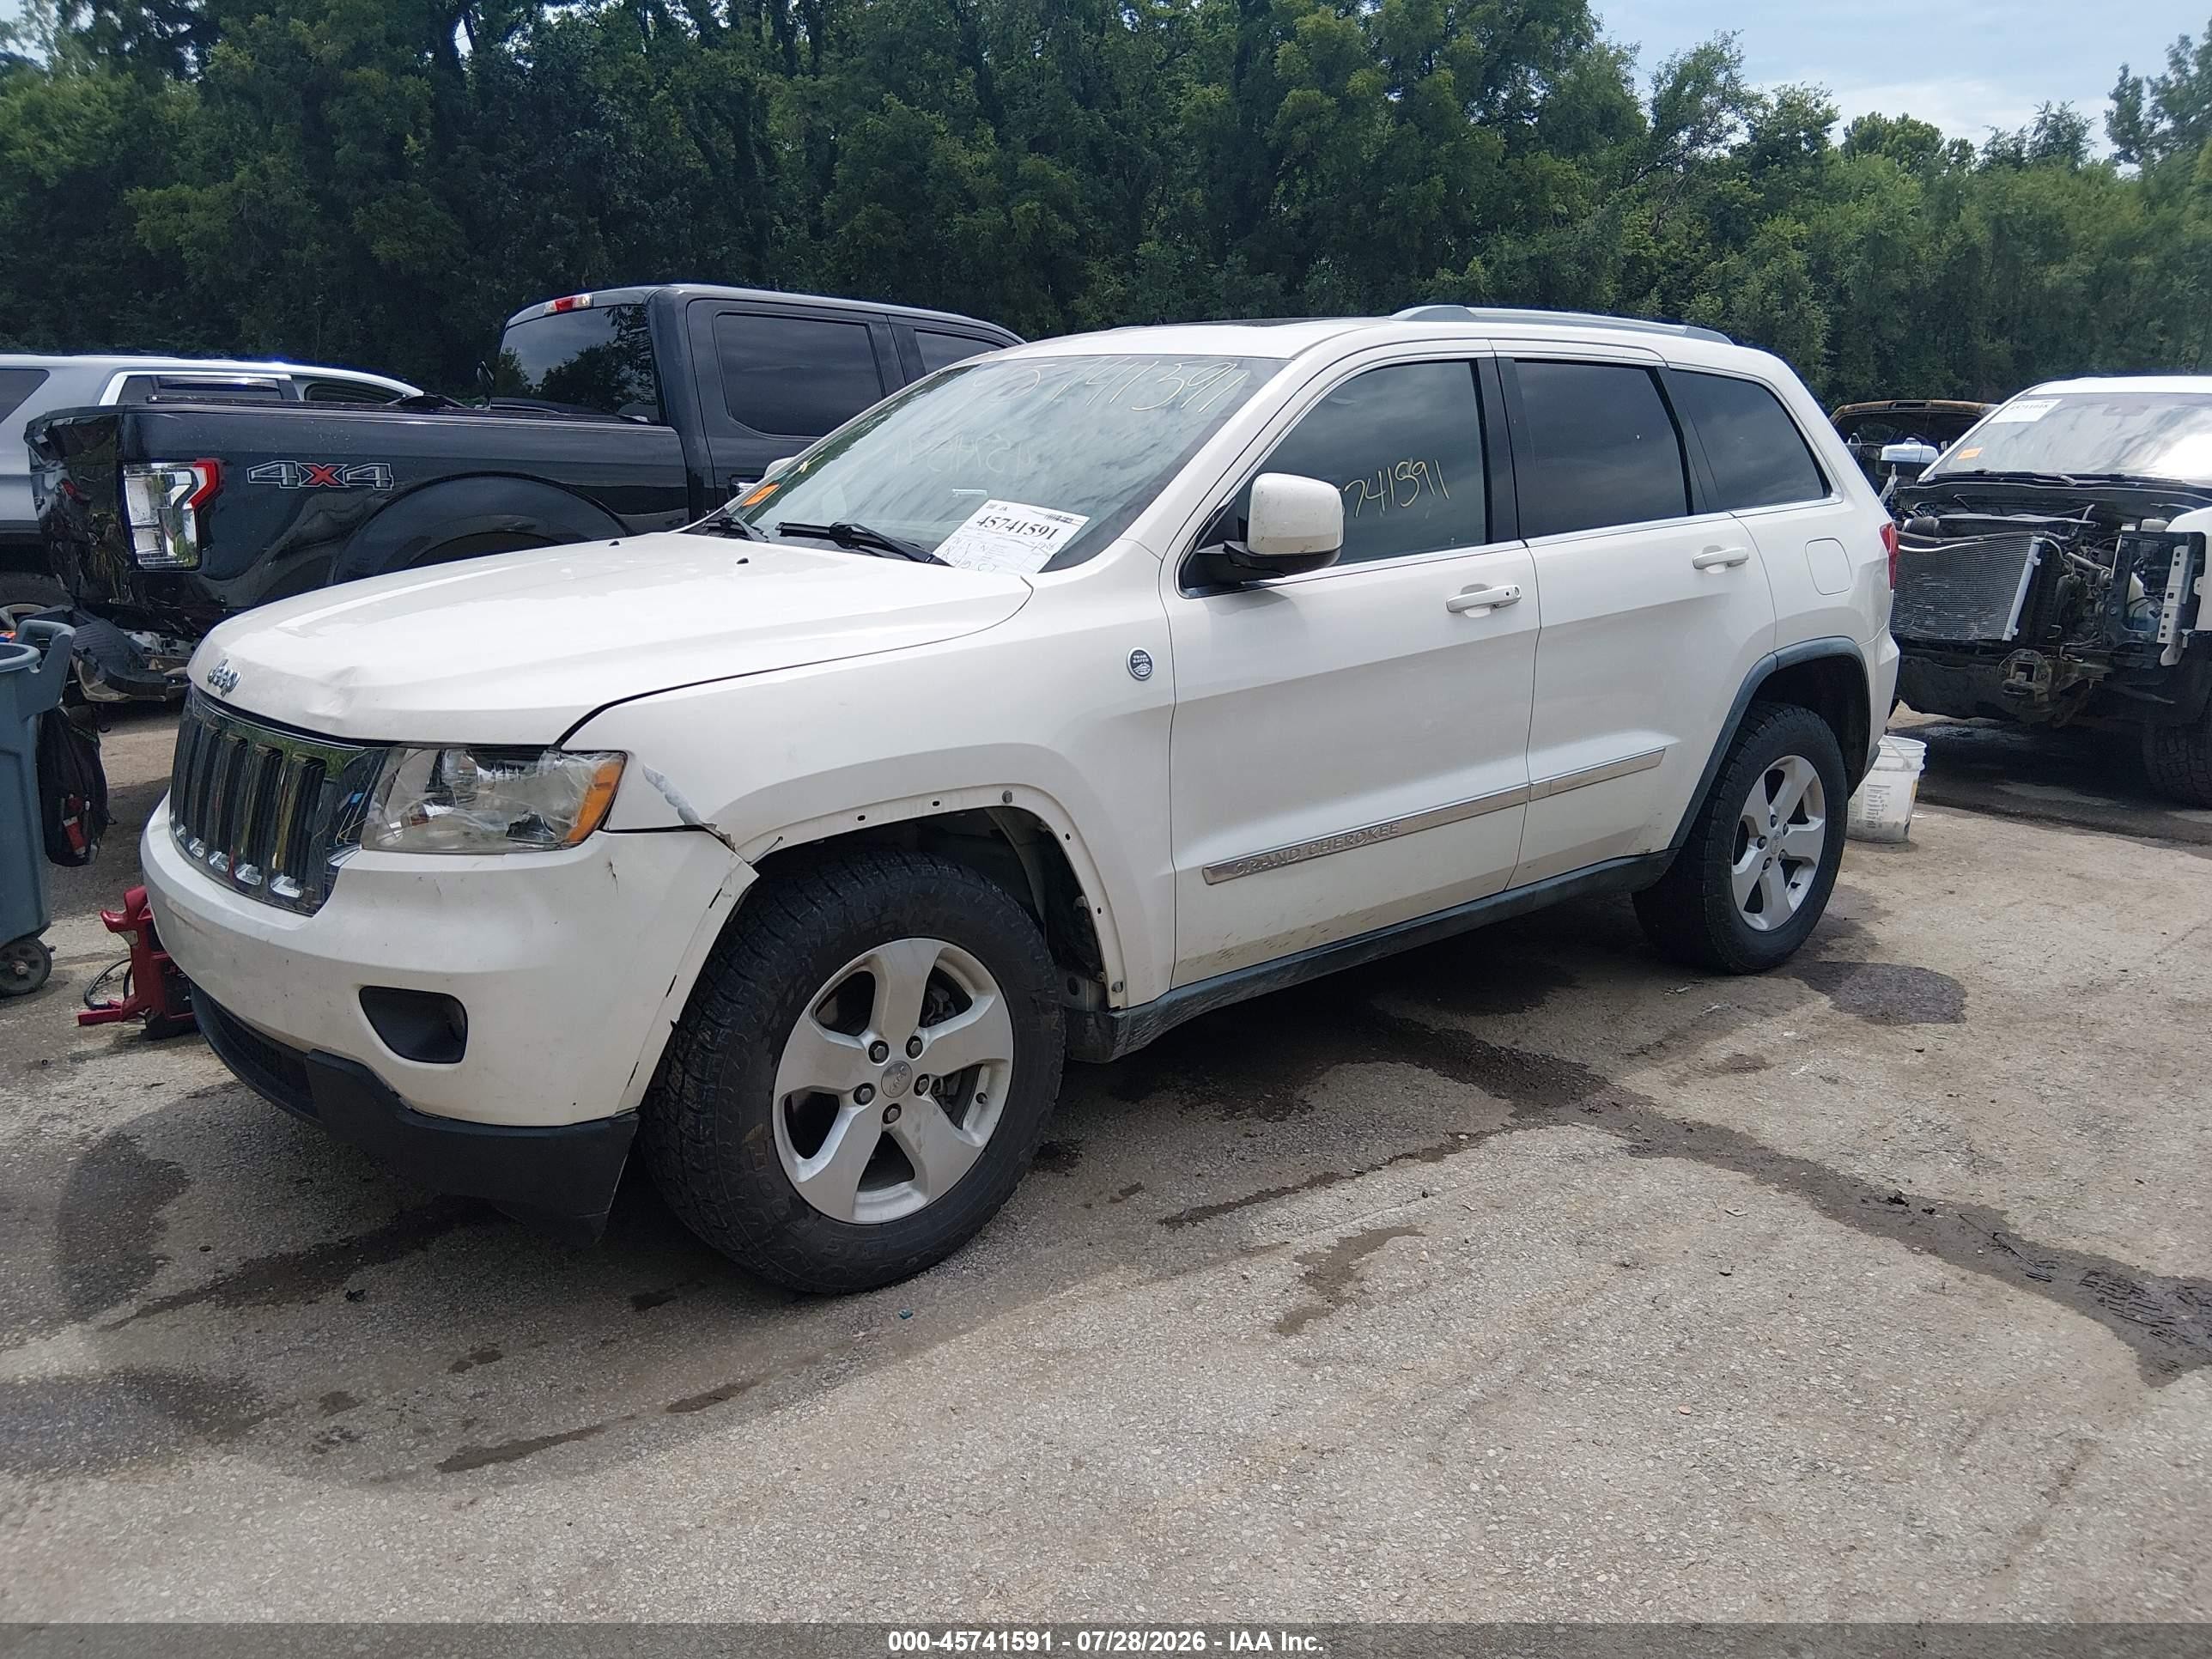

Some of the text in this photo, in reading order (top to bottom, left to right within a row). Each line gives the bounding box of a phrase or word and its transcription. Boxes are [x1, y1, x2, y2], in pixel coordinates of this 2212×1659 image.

[976, 515, 1060, 539] 45741591
[208, 659, 241, 697] Jeep
[1235, 822, 1401, 875] GRAND CHEROKEE
